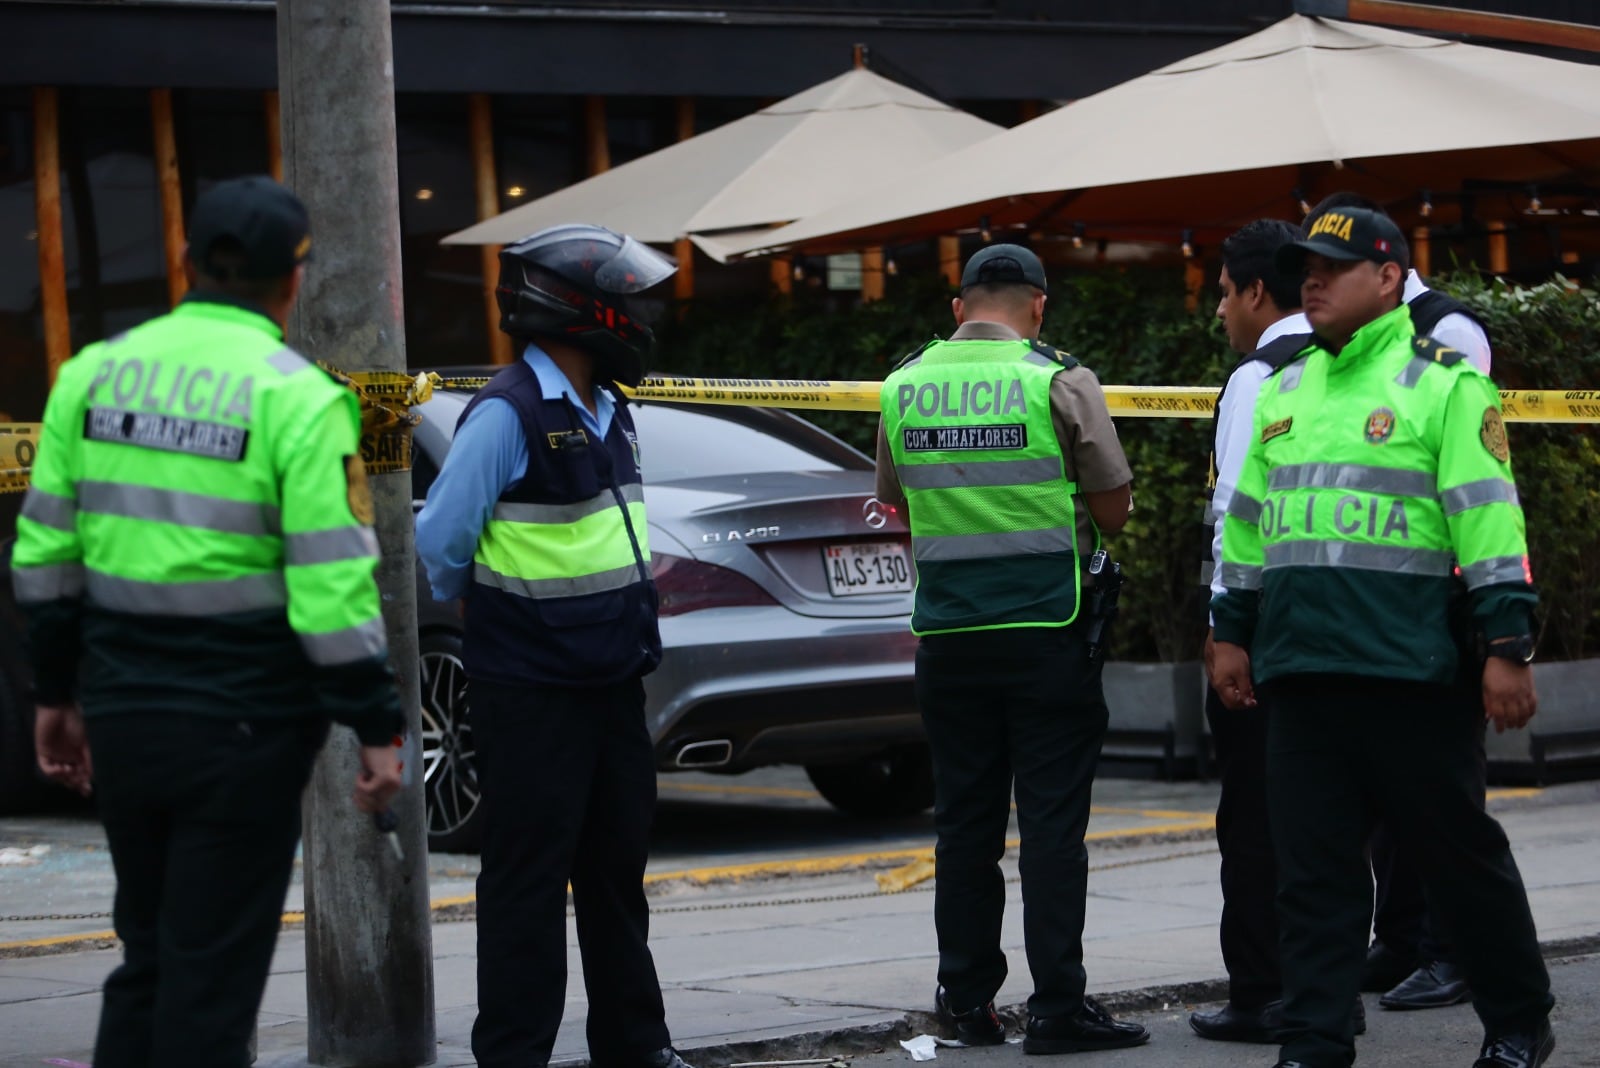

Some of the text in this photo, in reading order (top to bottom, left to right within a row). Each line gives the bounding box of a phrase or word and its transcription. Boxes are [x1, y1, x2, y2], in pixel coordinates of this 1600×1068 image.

[88, 358, 254, 423] POLICIA
[898, 378, 1028, 420] POLICIA
[905, 428, 1019, 449] COM. MIRAFLORES
[1262, 494, 1410, 540] OLICIA
[834, 555, 907, 587] ALS-130
